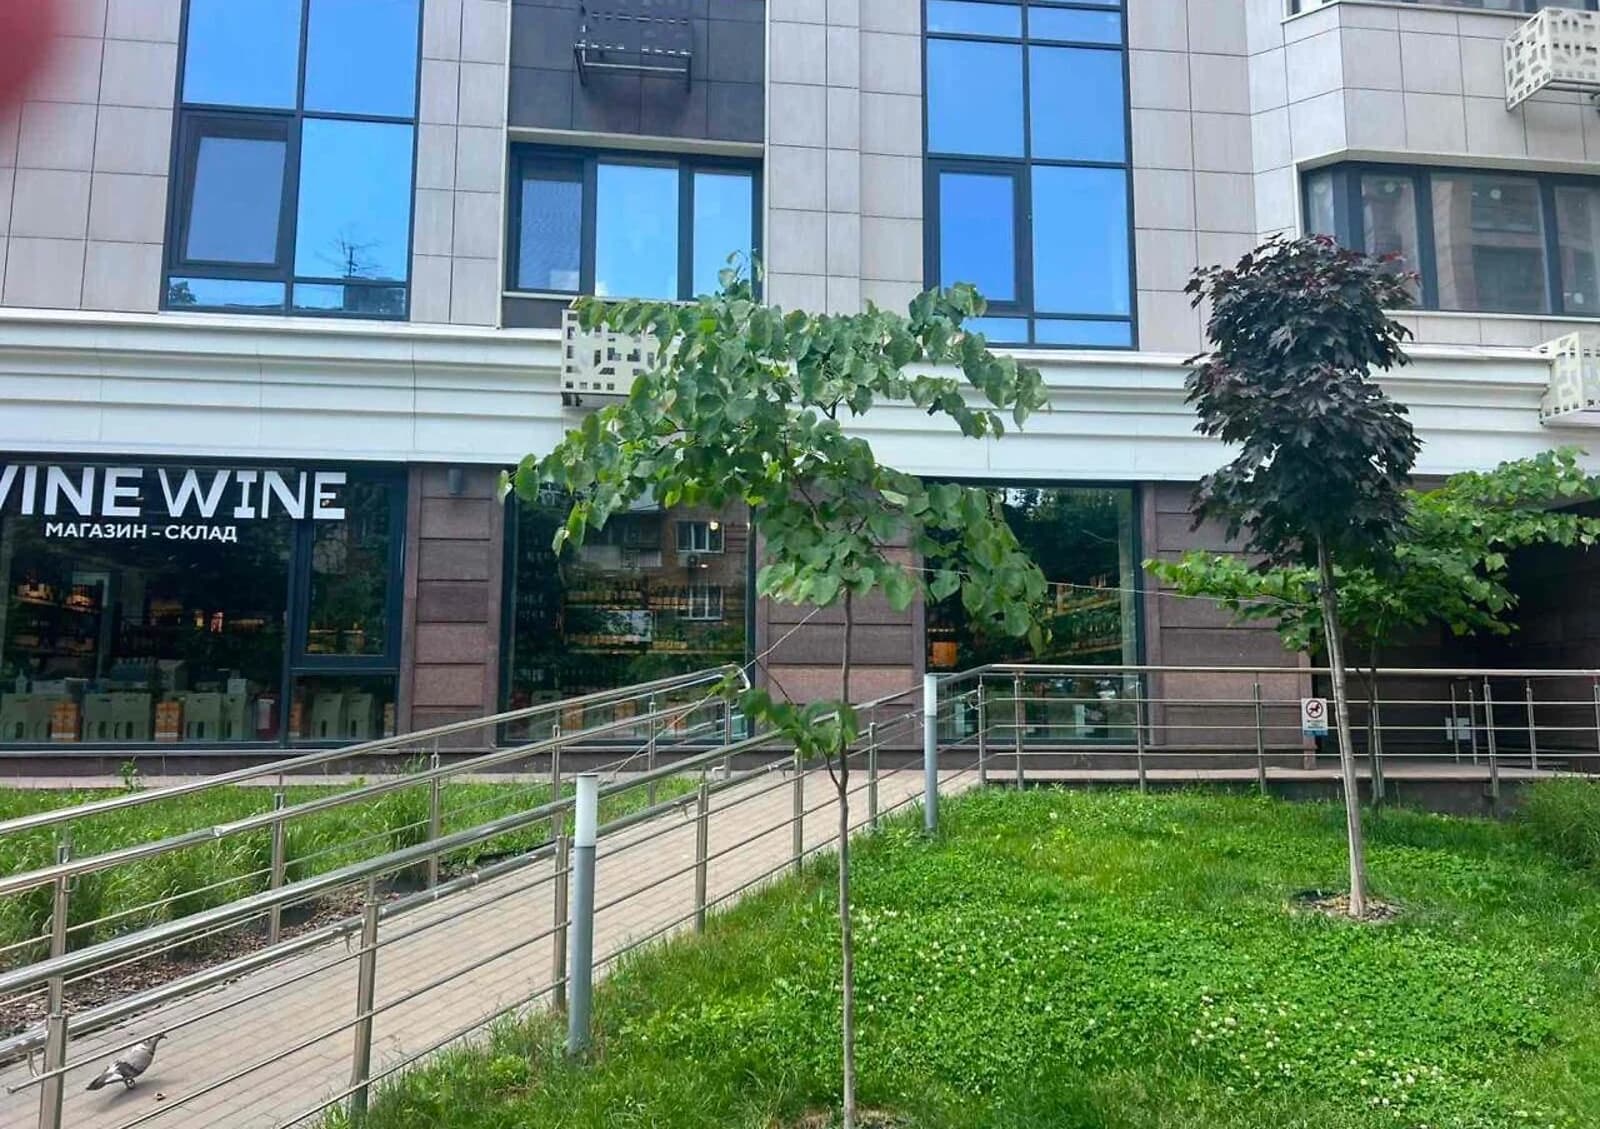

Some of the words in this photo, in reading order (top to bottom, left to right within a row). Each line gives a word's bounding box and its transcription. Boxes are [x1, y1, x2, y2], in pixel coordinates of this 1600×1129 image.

[0, 465, 143, 517] INE
[157, 468, 347, 520] WINE
[45, 522, 147, 539] МАГАЗИН
[164, 524, 238, 543] СКЛАД
